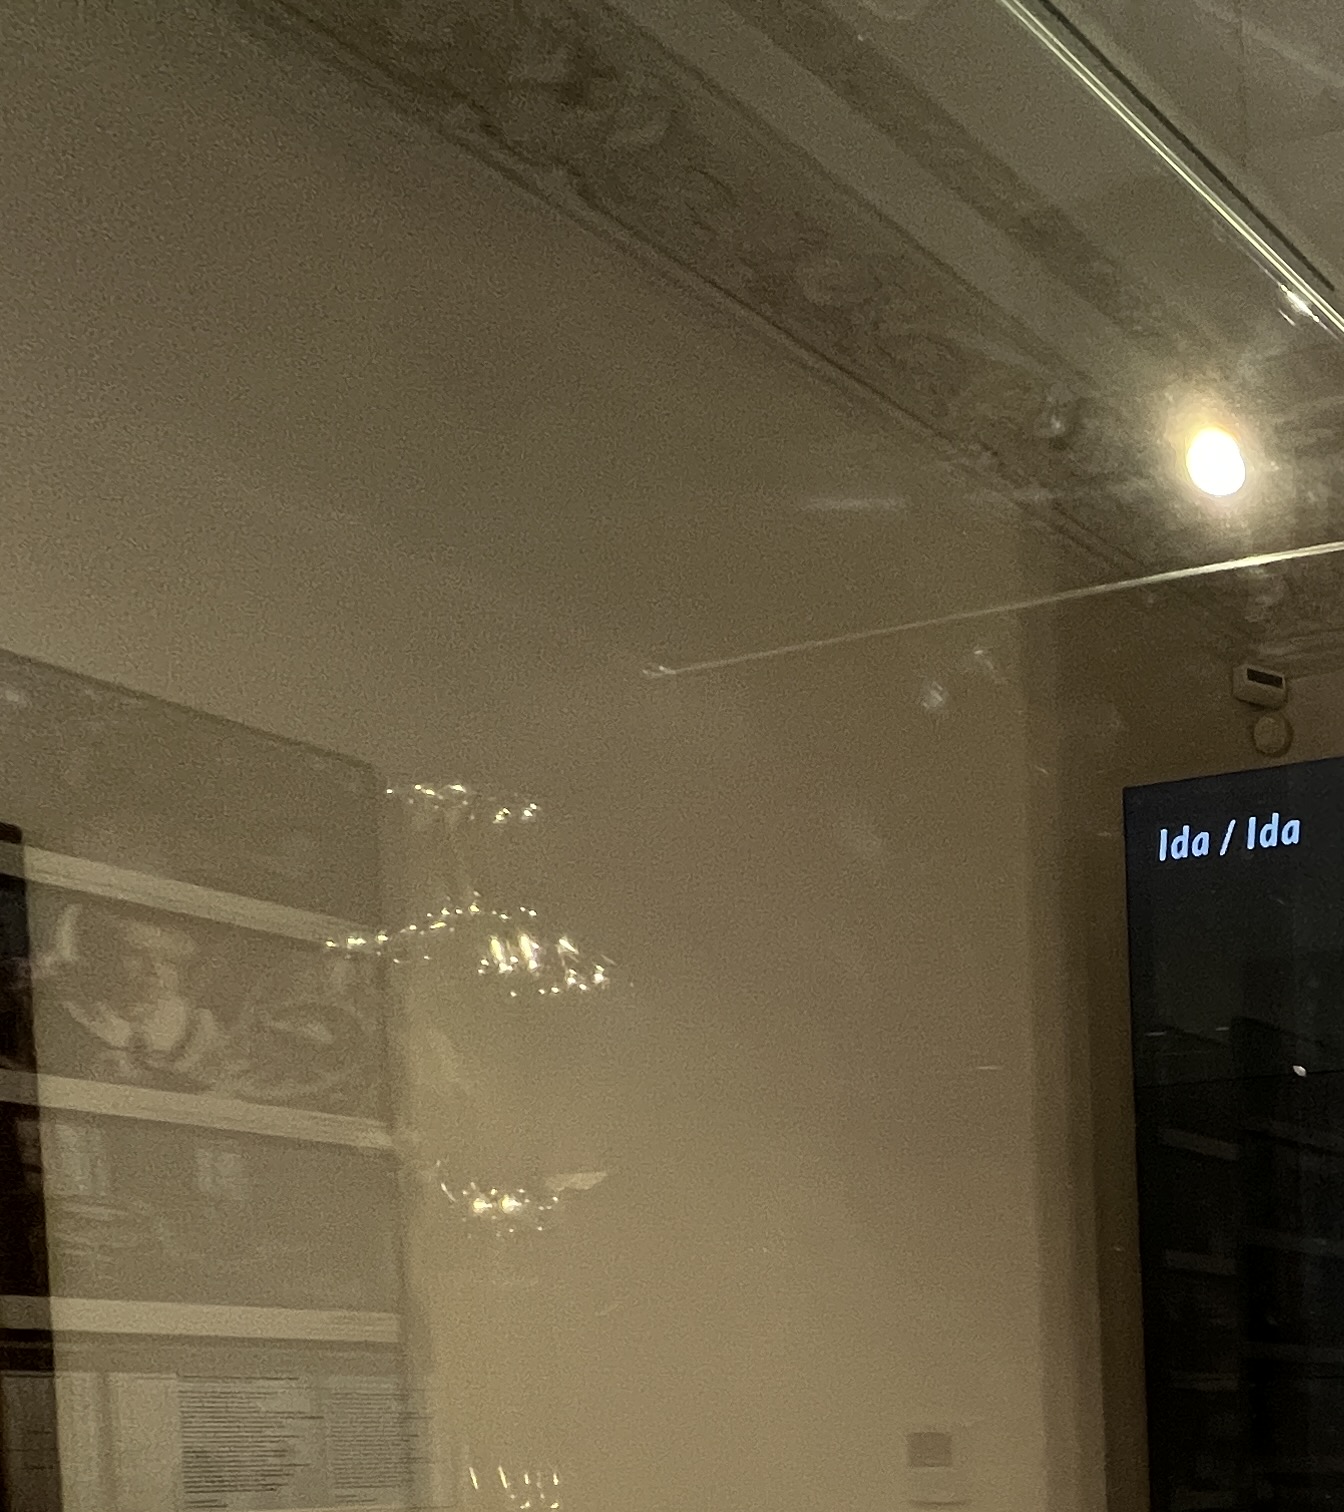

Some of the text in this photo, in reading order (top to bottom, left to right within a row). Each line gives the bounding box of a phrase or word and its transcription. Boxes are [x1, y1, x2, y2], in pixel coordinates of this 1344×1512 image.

[1159, 812, 1301, 862] Ida / Ida
